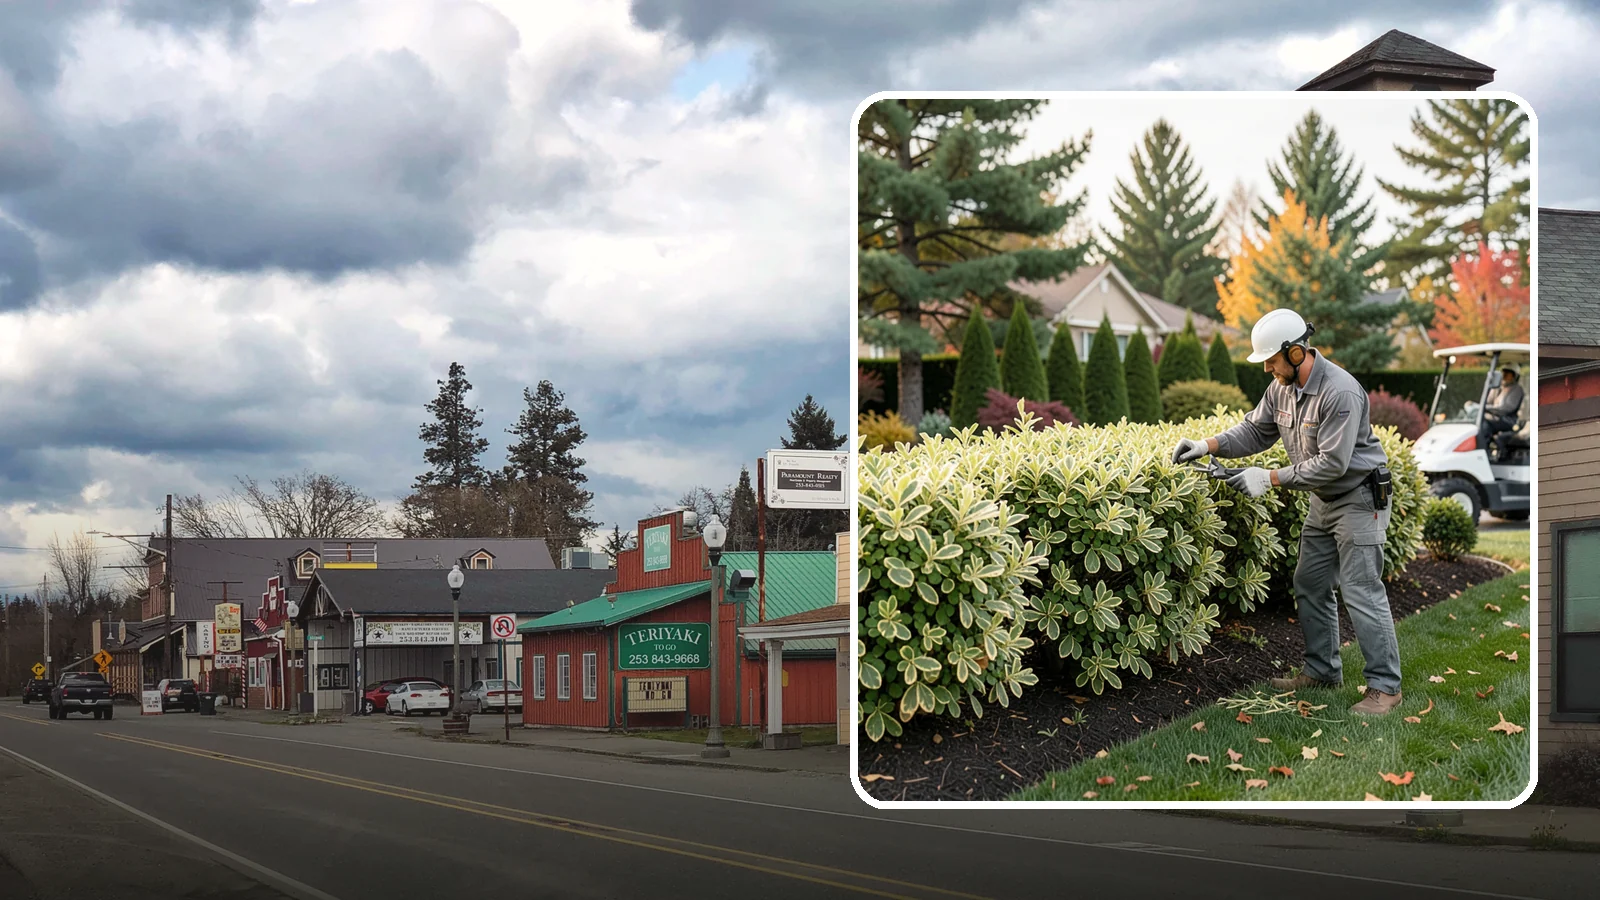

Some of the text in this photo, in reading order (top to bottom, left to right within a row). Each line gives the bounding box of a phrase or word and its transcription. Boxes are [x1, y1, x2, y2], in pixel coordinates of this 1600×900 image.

[817, 472, 839, 480] REALTY
[624, 627, 702, 646] TERIYAKI
[628, 653, 700, 665] 253 843-9668
